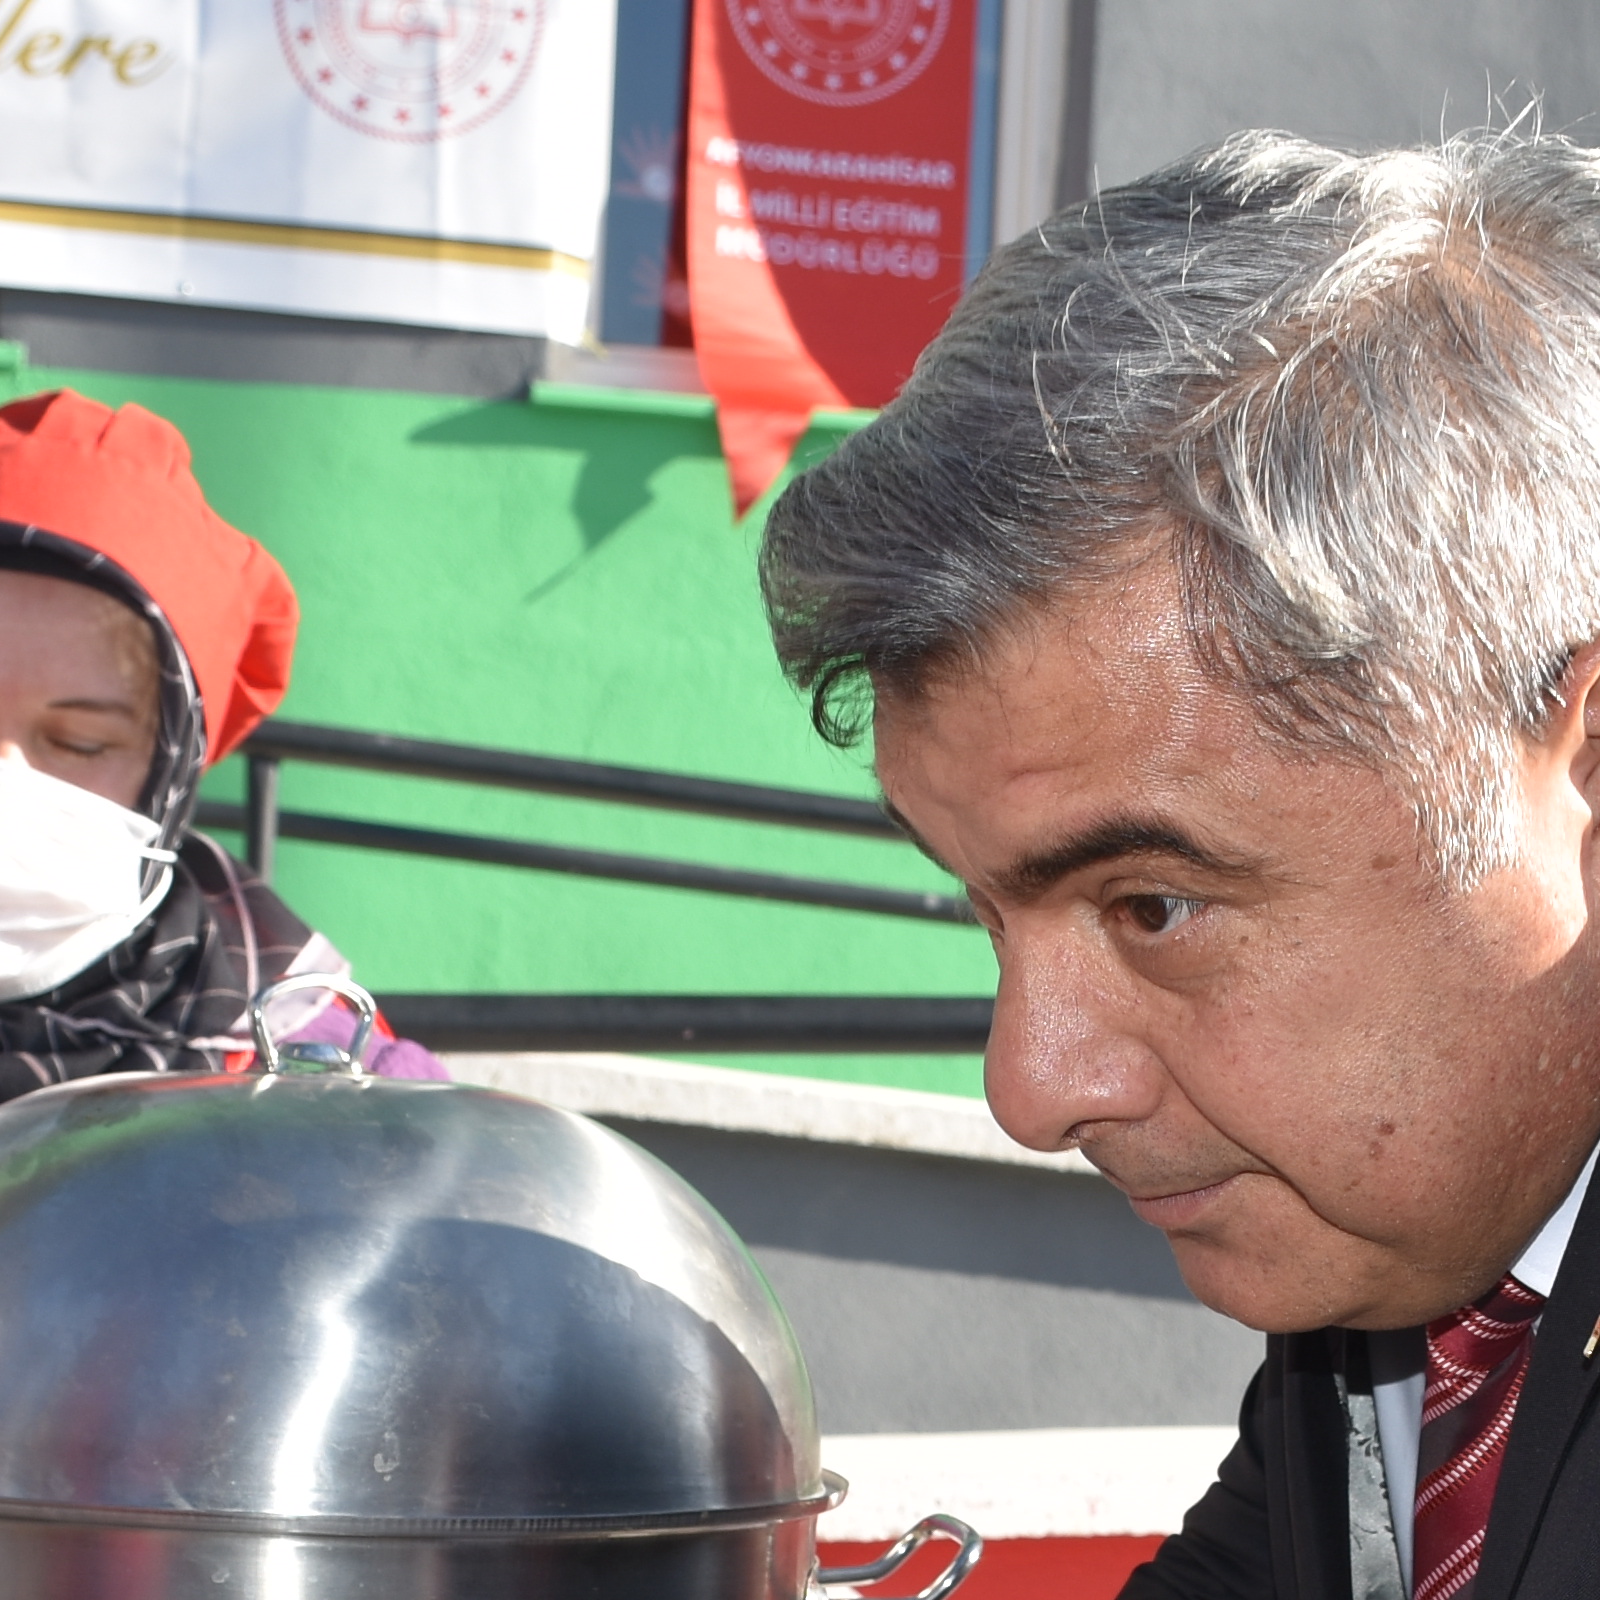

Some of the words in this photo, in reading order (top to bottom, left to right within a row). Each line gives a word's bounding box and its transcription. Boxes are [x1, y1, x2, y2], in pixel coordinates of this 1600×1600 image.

[706, 137, 956, 190] AFYONKARAHİSAR
[751, 186, 831, 229] MİLLİ
[833, 192, 942, 237] EĞİTİM
